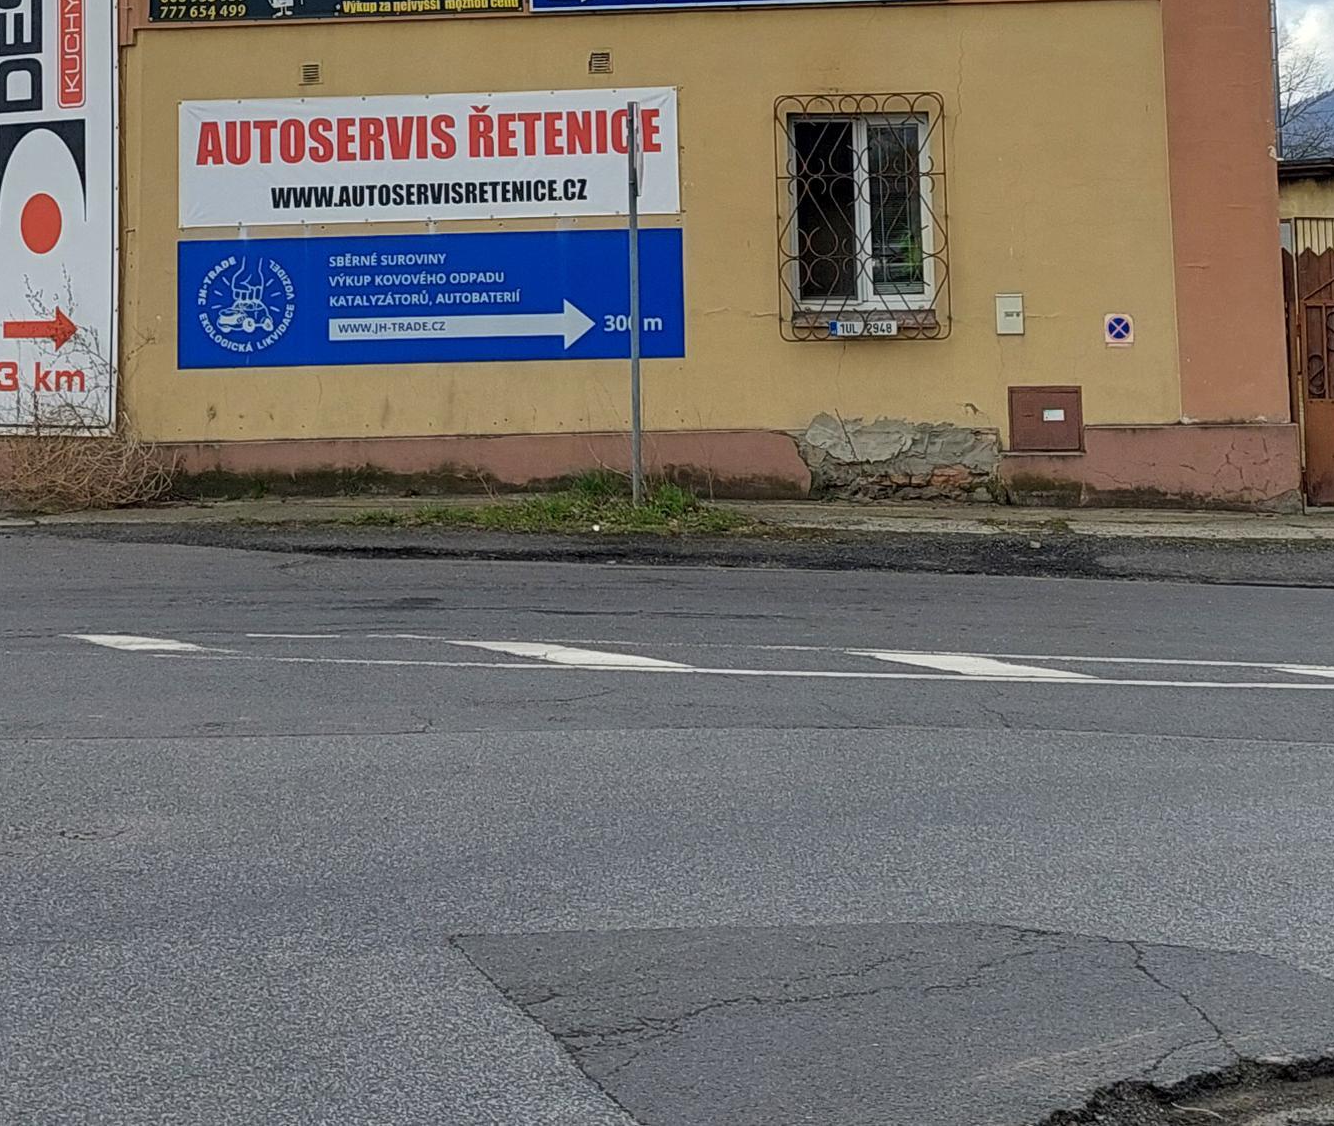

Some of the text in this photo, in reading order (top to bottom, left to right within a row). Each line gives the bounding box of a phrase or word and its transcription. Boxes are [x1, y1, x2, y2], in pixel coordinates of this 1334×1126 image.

[160, 4, 246, 19] 777 654 499
[342, 0, 378, 14] Výkup
[379, 1, 391, 12] za
[195, 104, 662, 166] AUTOSERVIS ŘETENICE
[271, 178, 588, 209] WWW.AUTOSERVISRETENICE.CZ
[329, 252, 447, 267] SBĚRNÉ SUROVINY
[329, 271, 505, 287] VÝKUP KOVOVÉHO ODPADU
[329, 288, 521, 307] KATALYZÁTORŮ, AUTOBATERIÍ
[199, 259, 295, 353] EKOLOGICKÁ LIKVIDACE VOZIDEL
[338, 321, 446, 334] WWW.JH-TRADE.CZ
[643, 317, 663, 331] m
[840, 323, 859, 334] 1UL
[34, 361, 86, 392] km
